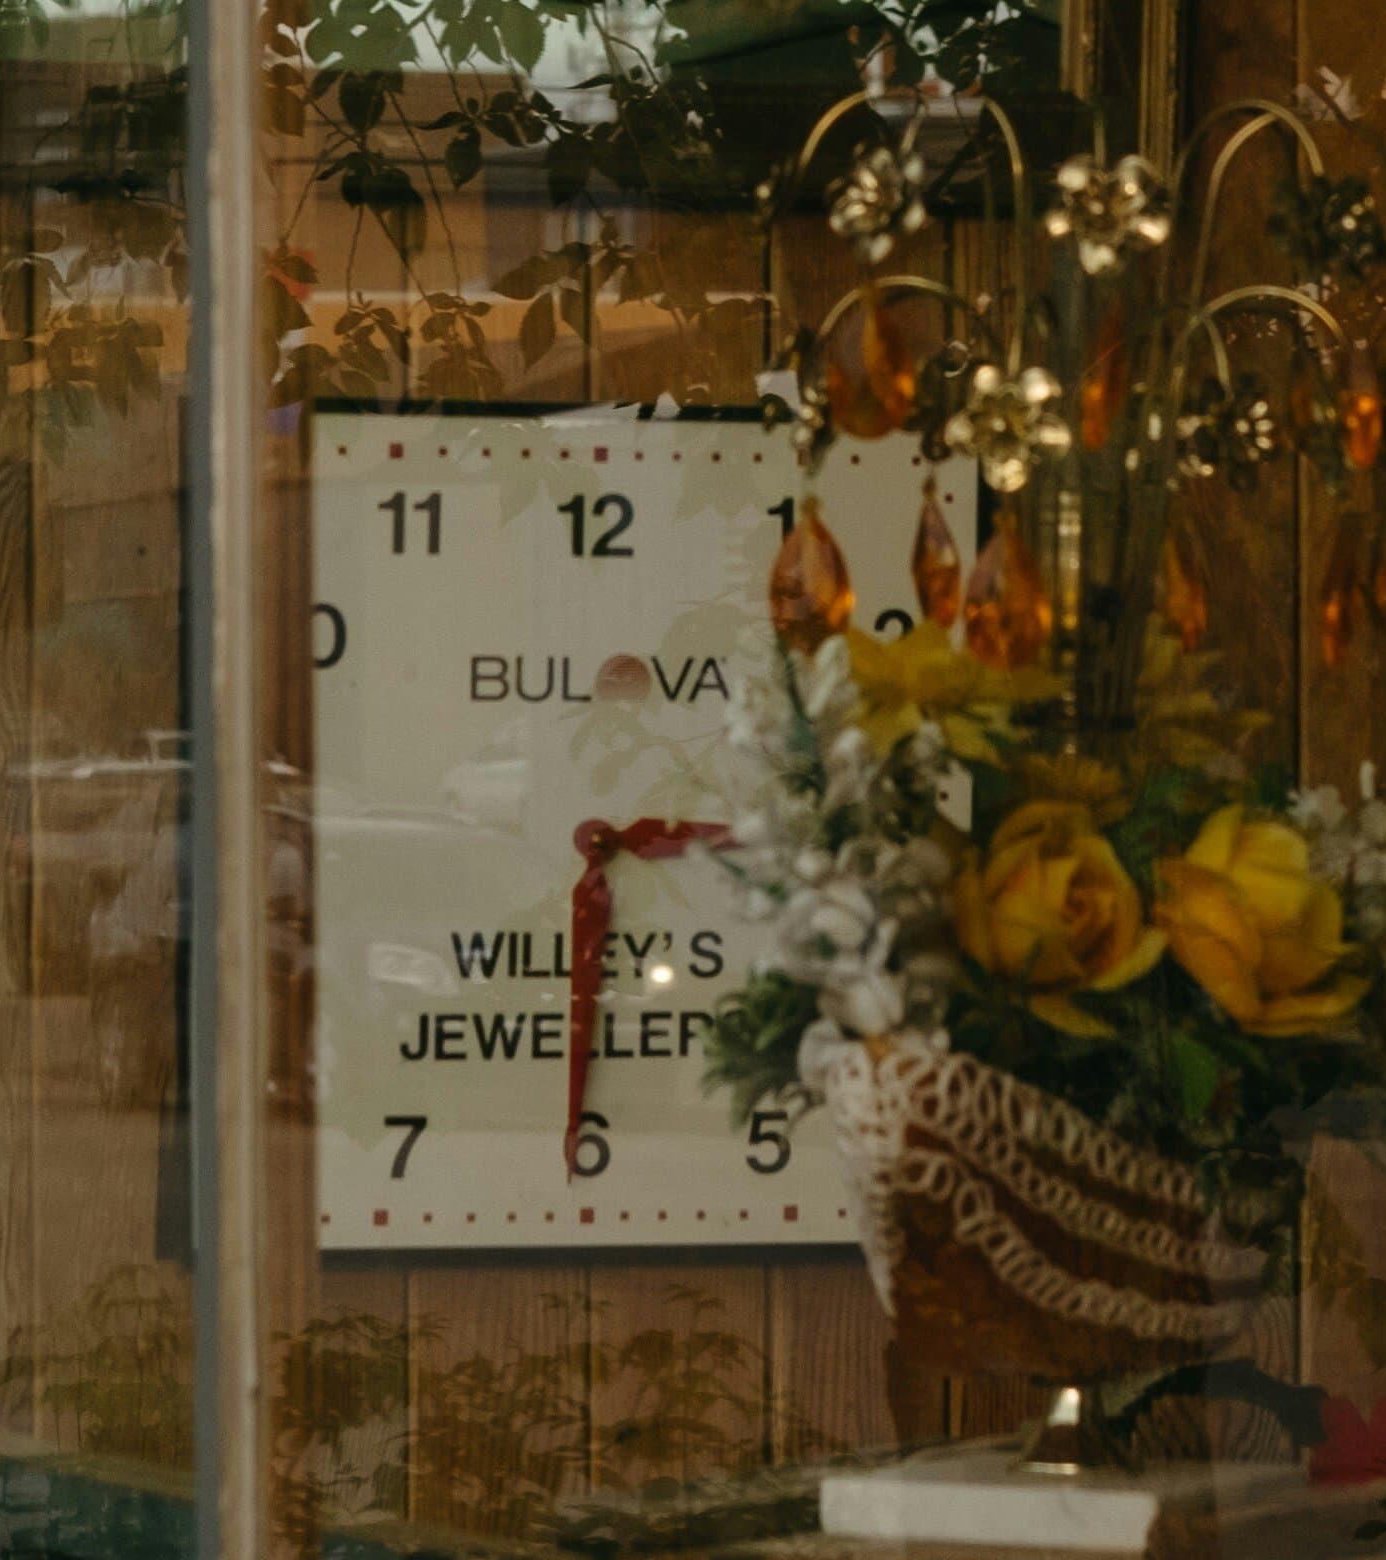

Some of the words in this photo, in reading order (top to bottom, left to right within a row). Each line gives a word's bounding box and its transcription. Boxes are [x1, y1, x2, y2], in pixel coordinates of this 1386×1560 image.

[378, 492, 442, 554] 11
[557, 493, 634, 557] 12
[384, 1115, 428, 1179] 7
[565, 1110, 611, 1177] 6
[745, 1110, 792, 1174] 5
